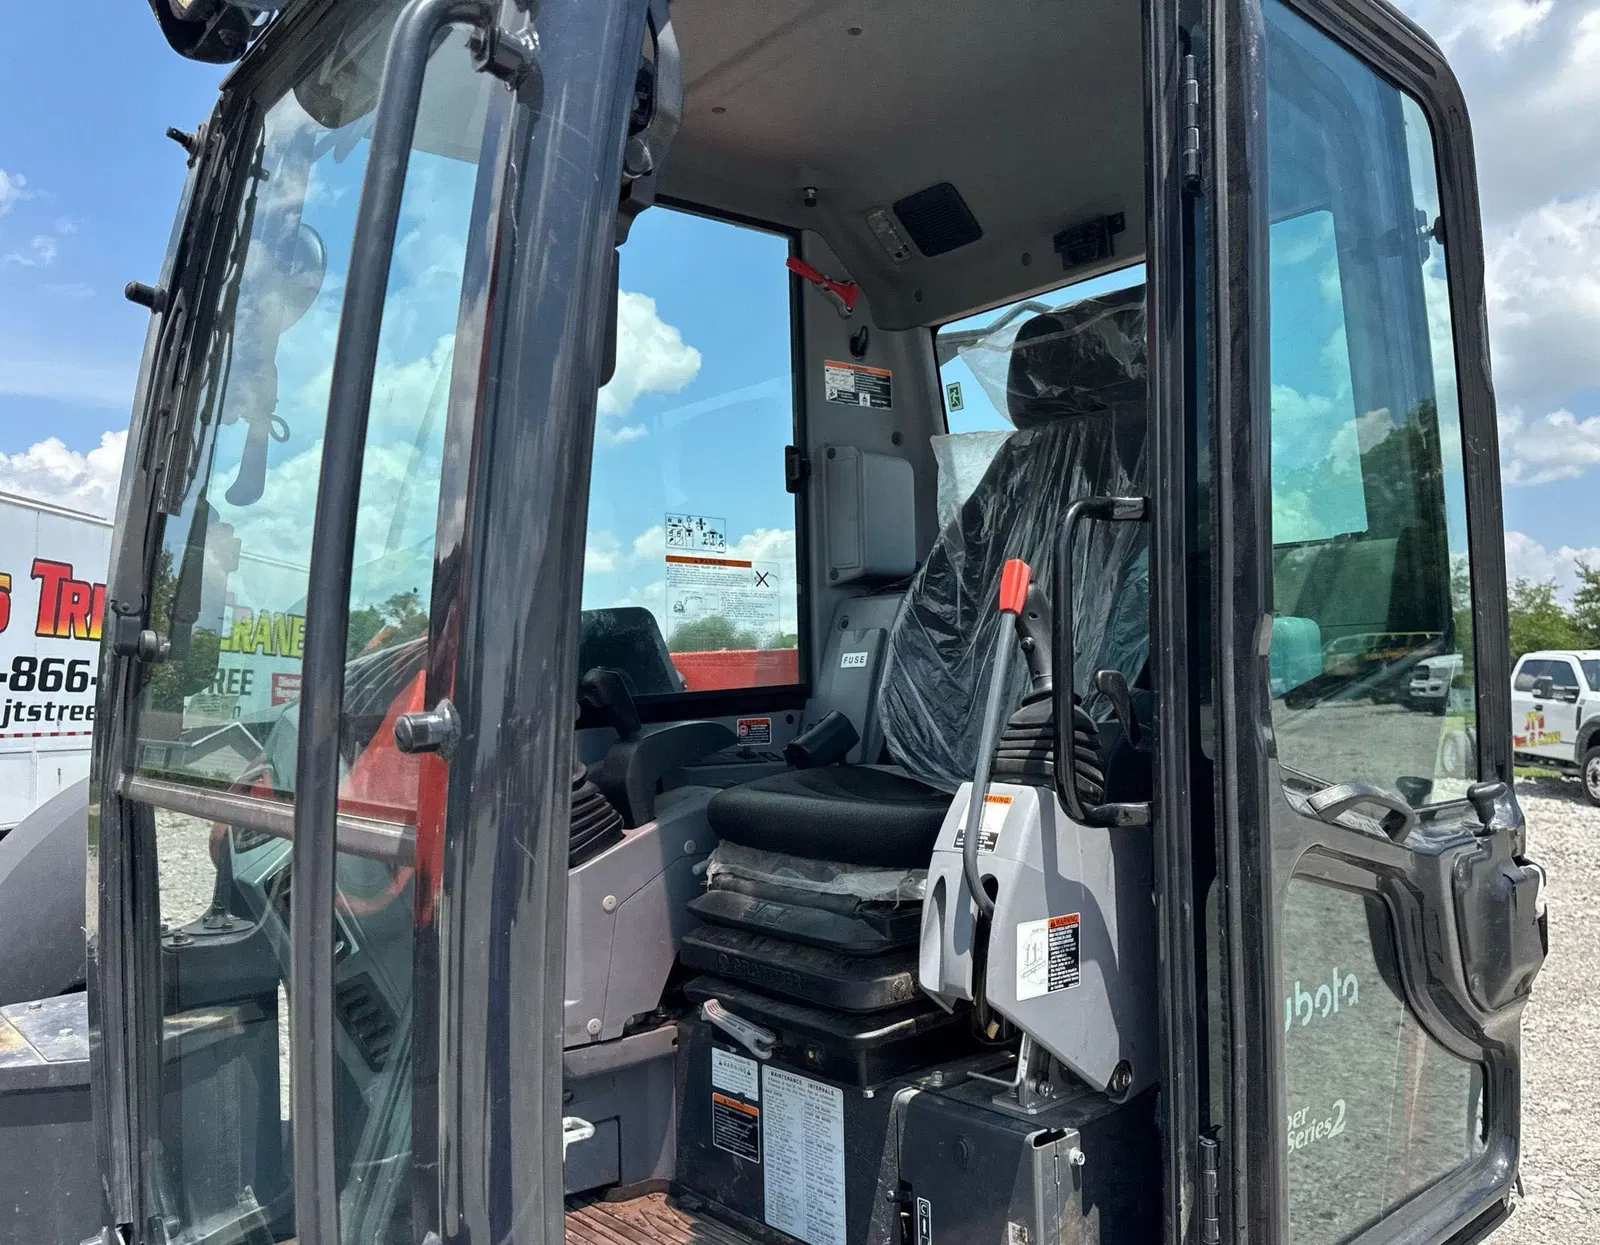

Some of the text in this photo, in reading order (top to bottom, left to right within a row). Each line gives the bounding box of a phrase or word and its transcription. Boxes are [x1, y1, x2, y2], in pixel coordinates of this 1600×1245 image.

[843, 655, 865, 664] FUSE
[1055, 914, 1078, 926] WARNING
[770, 1070, 803, 1086] MAINTENANCE
[807, 1079, 835, 1097] INTERVALS
